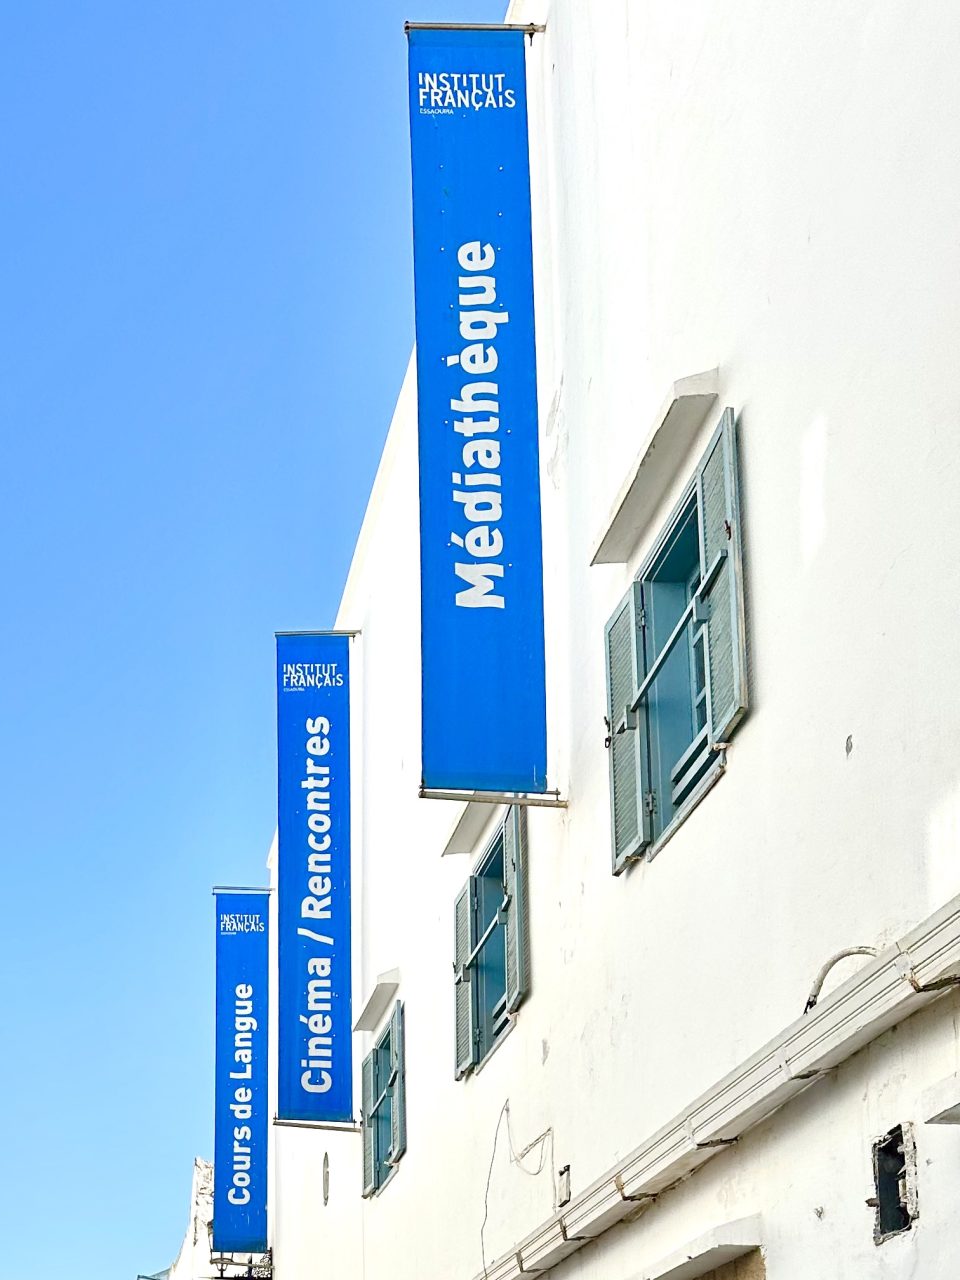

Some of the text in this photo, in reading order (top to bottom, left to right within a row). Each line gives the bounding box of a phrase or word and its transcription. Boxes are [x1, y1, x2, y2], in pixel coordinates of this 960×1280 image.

[418, 72, 506, 92] INSTITUT
[418, 88, 516, 111] FRANÇAIS
[446, 240, 509, 609] Médiathèque
[282, 663, 338, 677] INSTITUT
[282, 673, 344, 689] FRANÇAIS
[297, 715, 334, 1094] Cinéma / Rencontres
[220, 913, 260, 923] INSTITUT
[220, 921, 265, 933] FRANÇAIS
[227, 983, 258, 1206] Cours de Langue
